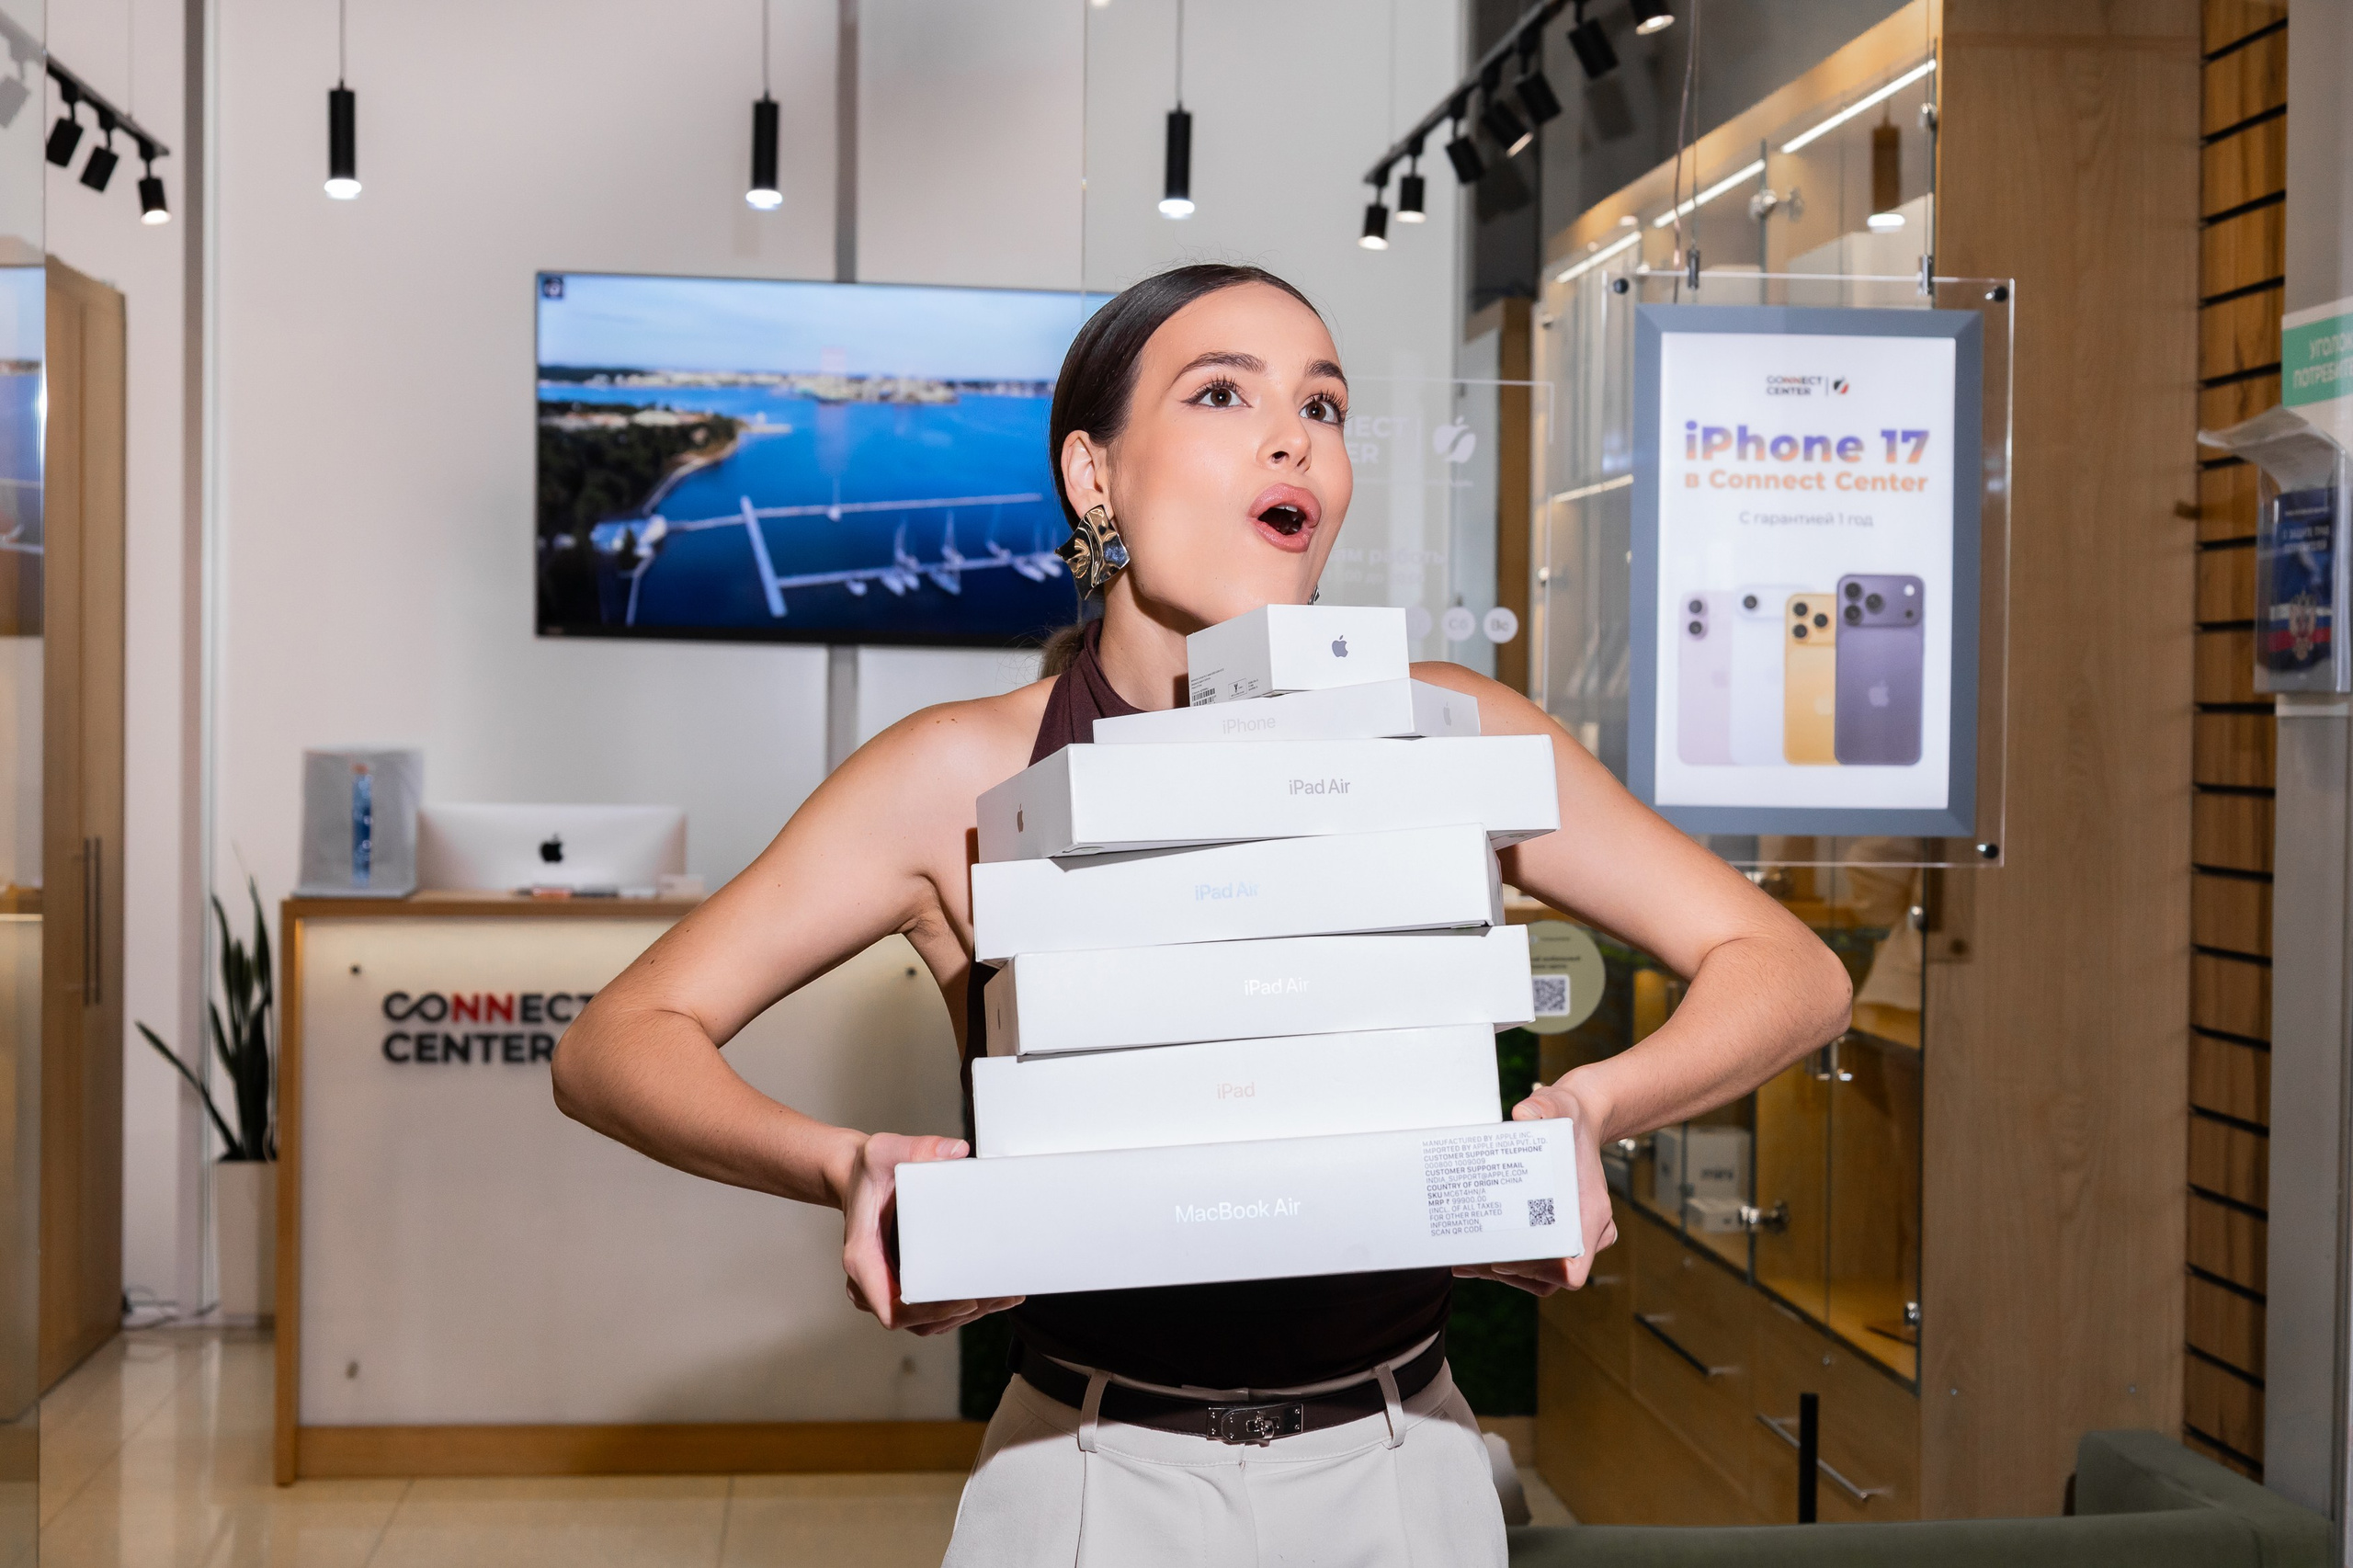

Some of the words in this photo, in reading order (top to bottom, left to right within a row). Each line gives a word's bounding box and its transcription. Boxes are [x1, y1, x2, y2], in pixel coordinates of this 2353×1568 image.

[1766, 375, 1822, 385] CONNECT
[1766, 387, 1811, 395] CENTER
[1685, 419, 1864, 463] iPhone
[1881, 429, 1930, 464] 17
[1709, 470, 1825, 491] Connect
[1835, 472, 1928, 493] Center
[1847, 514, 1874, 528] год
[1222, 718, 1276, 734] iPhone
[1289, 779, 1324, 795] iPad
[1328, 778, 1350, 794] Air
[1195, 882, 1233, 901] iPad
[1236, 881, 1259, 898] Air
[1245, 978, 1282, 996] iPad
[1286, 977, 1310, 994] Air
[382, 1031, 553, 1063] CENTER
[1217, 1081, 1256, 1099] iPad
[1422, 1135, 1482, 1147] MANUFACTURED
[1495, 1132, 1518, 1141] APPLE
[1423, 1146, 1461, 1154] IMPORTED
[1472, 1142, 1494, 1151] APPLE
[1424, 1153, 1463, 1162] CUSTOMER
[1465, 1149, 1499, 1158] SUPPORT
[1501, 1145, 1542, 1154] TELEPHONE
[1425, 1167, 1465, 1176] CUSTOMER
[1467, 1164, 1500, 1173] SUPPORT
[1427, 1183, 1461, 1192] COUNTRY
[1473, 1179, 1499, 1187] ORIGIN
[1175, 1199, 1270, 1223] MacBook
[1274, 1197, 1301, 1217] Air
[1428, 1199, 1444, 1207] MRP
[1477, 1201, 1502, 1210] TAXES)
[1446, 1211, 1470, 1220] OTHER
[1471, 1209, 1503, 1218] RELATED
[1452, 1227, 1462, 1235] QR
[1463, 1225, 1483, 1233] CODE
